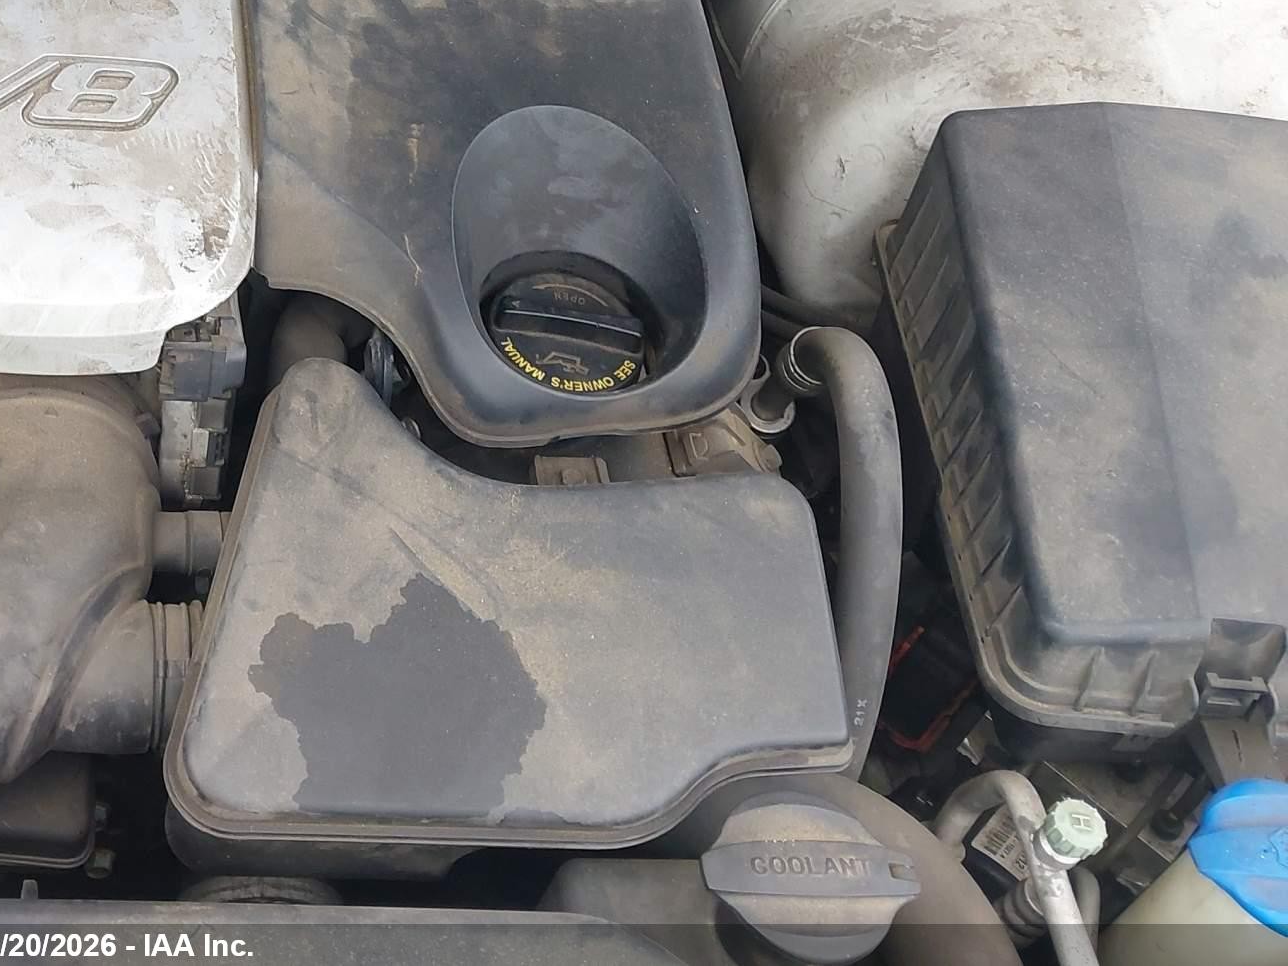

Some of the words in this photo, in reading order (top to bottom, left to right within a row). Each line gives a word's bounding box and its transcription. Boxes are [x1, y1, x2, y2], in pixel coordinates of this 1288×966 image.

[500, 336, 546, 381] MANUAL
[614, 359, 637, 381] SEE
[550, 376, 616, 392] OWNER'S
[749, 856, 873, 877] COOLANT
